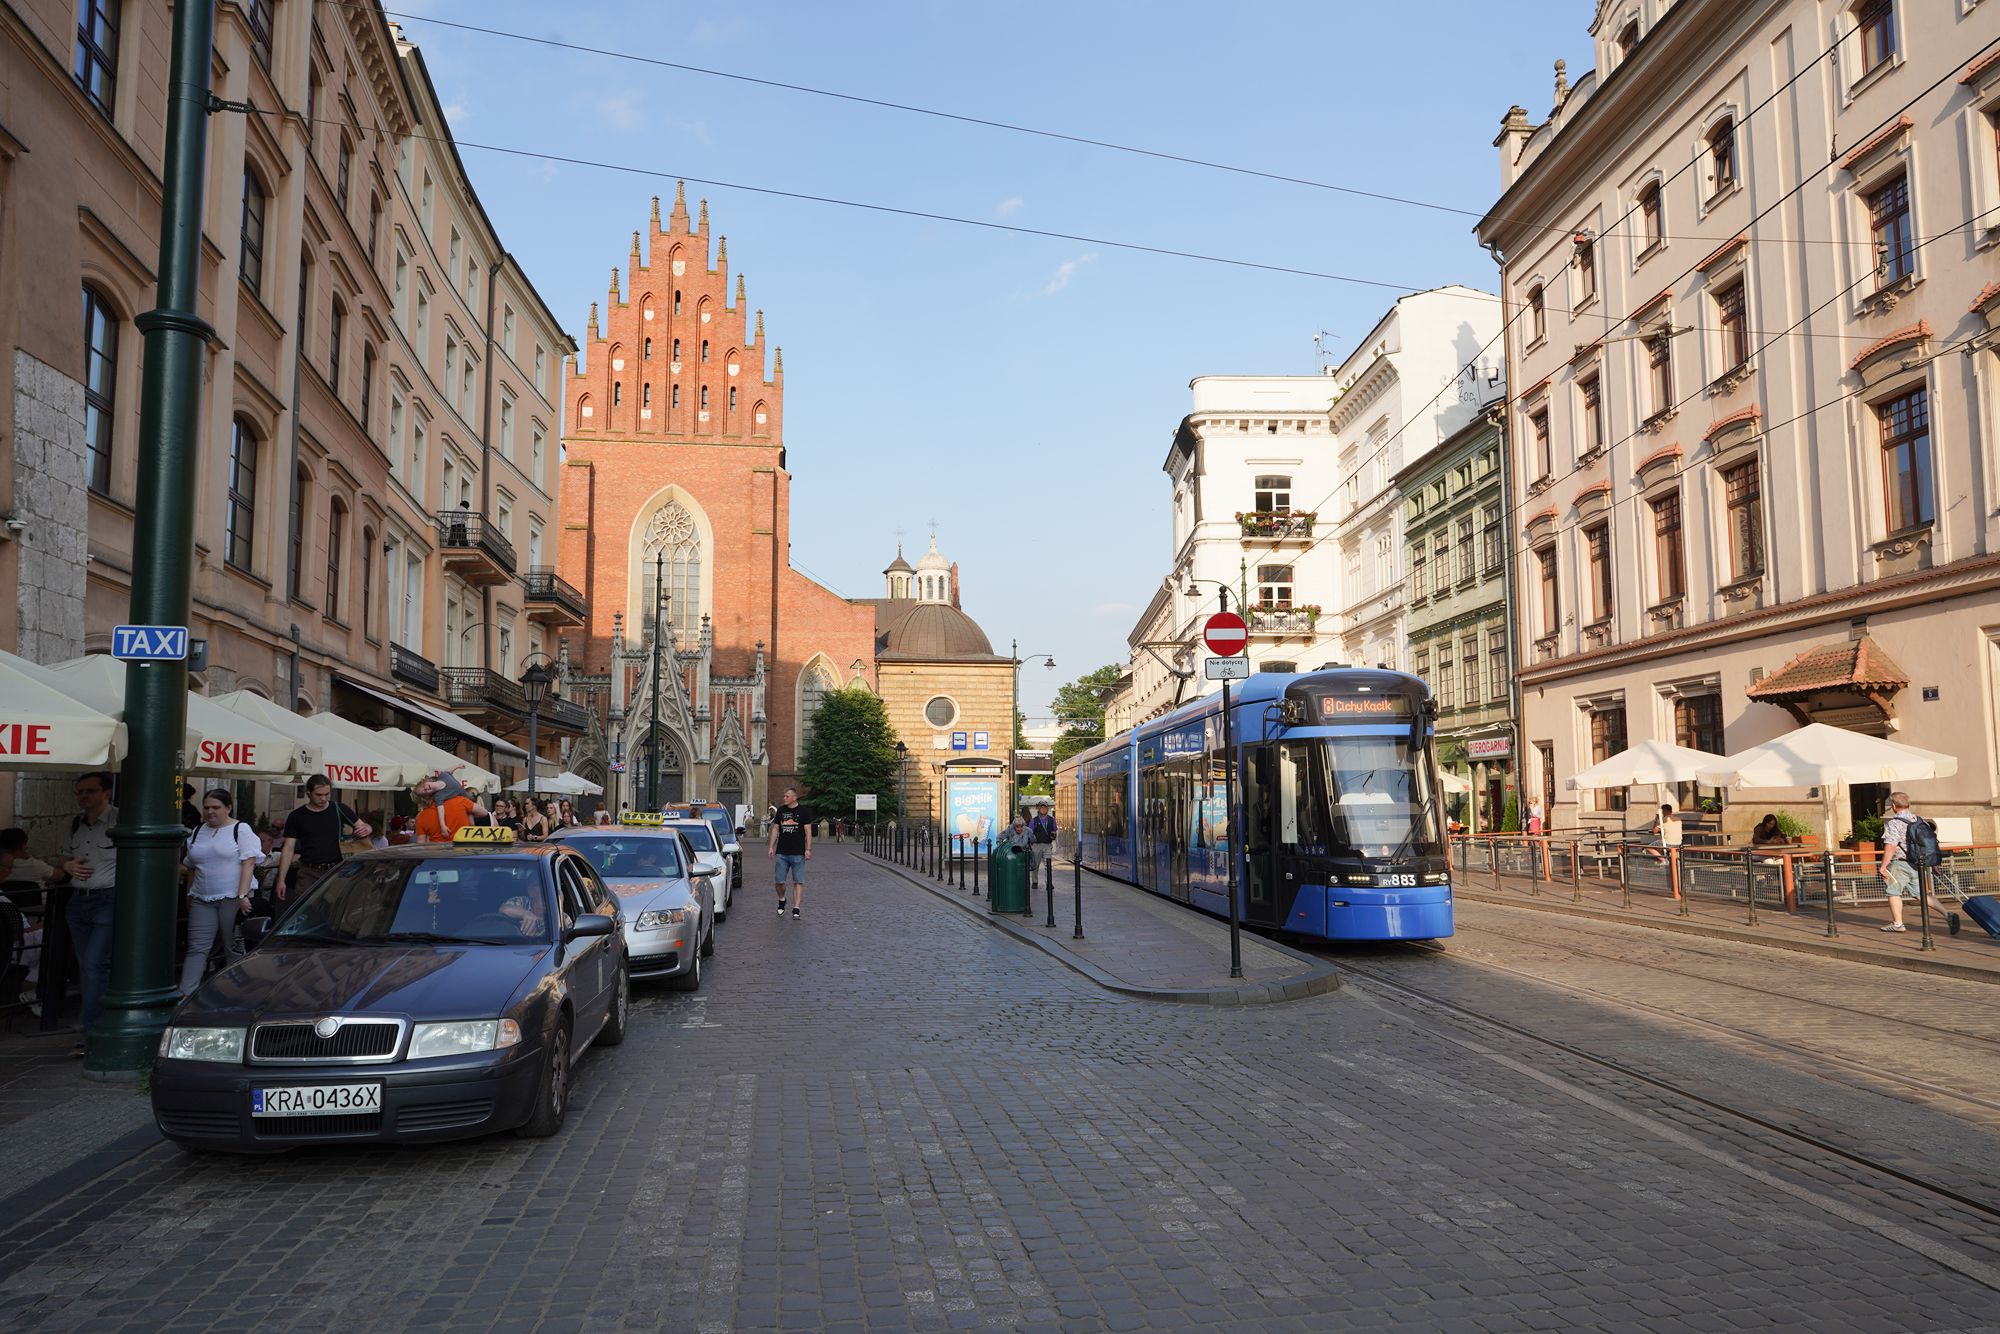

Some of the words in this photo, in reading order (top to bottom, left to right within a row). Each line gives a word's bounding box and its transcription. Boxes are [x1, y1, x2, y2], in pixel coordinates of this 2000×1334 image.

[117, 629, 184, 656] TAXI
[1324, 698, 1334, 715] 8
[201, 740, 256, 766] SKIE
[324, 764, 380, 783] TYSKIE
[954, 792, 993, 807] BigMilk
[629, 813, 657, 821] TAXI
[463, 827, 506, 841] TAXI
[265, 1090, 305, 1112] KRA
[313, 1086, 378, 1109] 0436X
